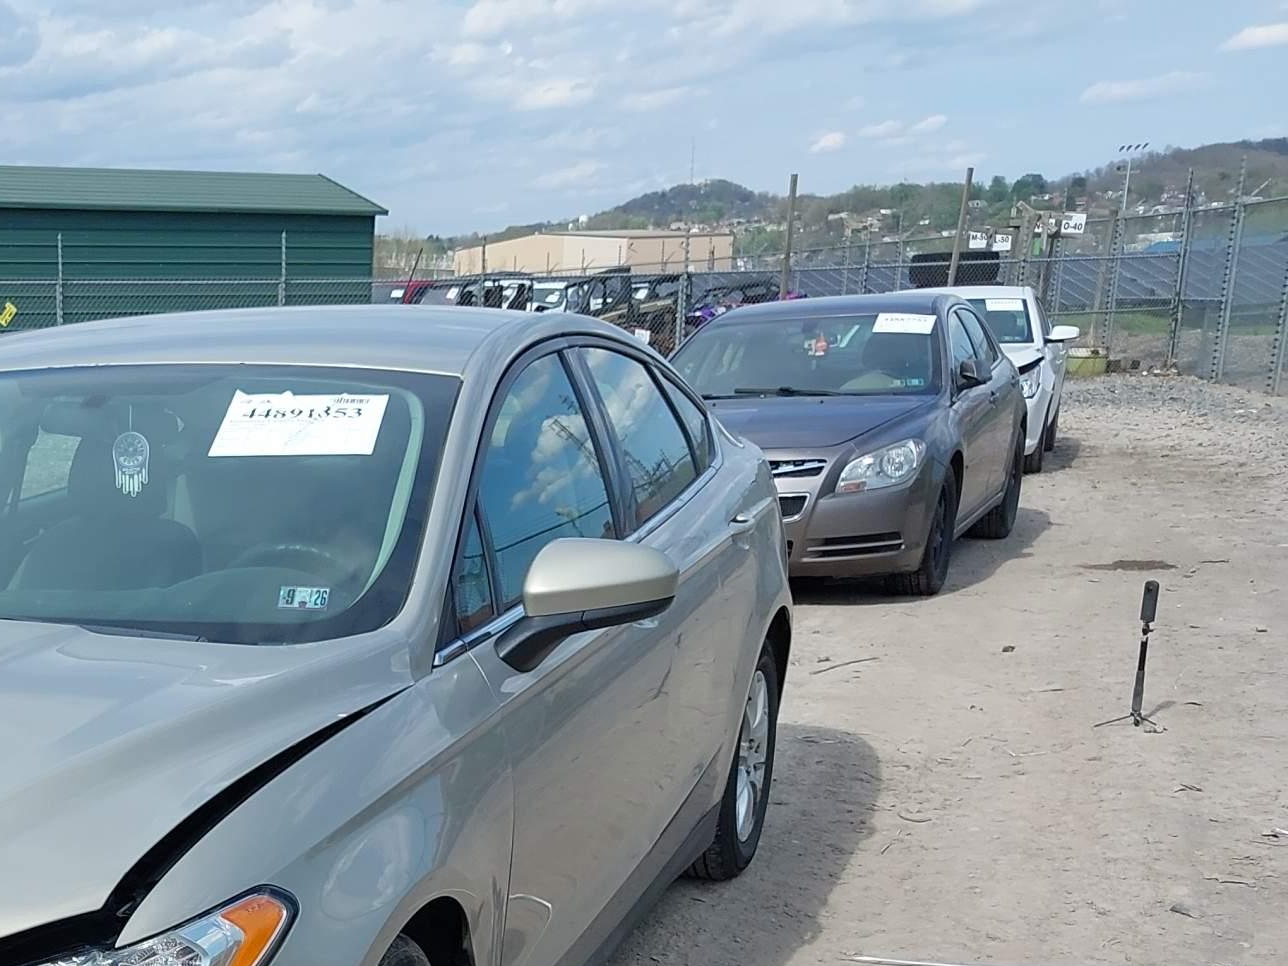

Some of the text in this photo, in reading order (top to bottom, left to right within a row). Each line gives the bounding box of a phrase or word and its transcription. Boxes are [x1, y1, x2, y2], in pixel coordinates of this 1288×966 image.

[241, 405, 363, 419] 44891353
[285, 588, 328, 606] 9 26
